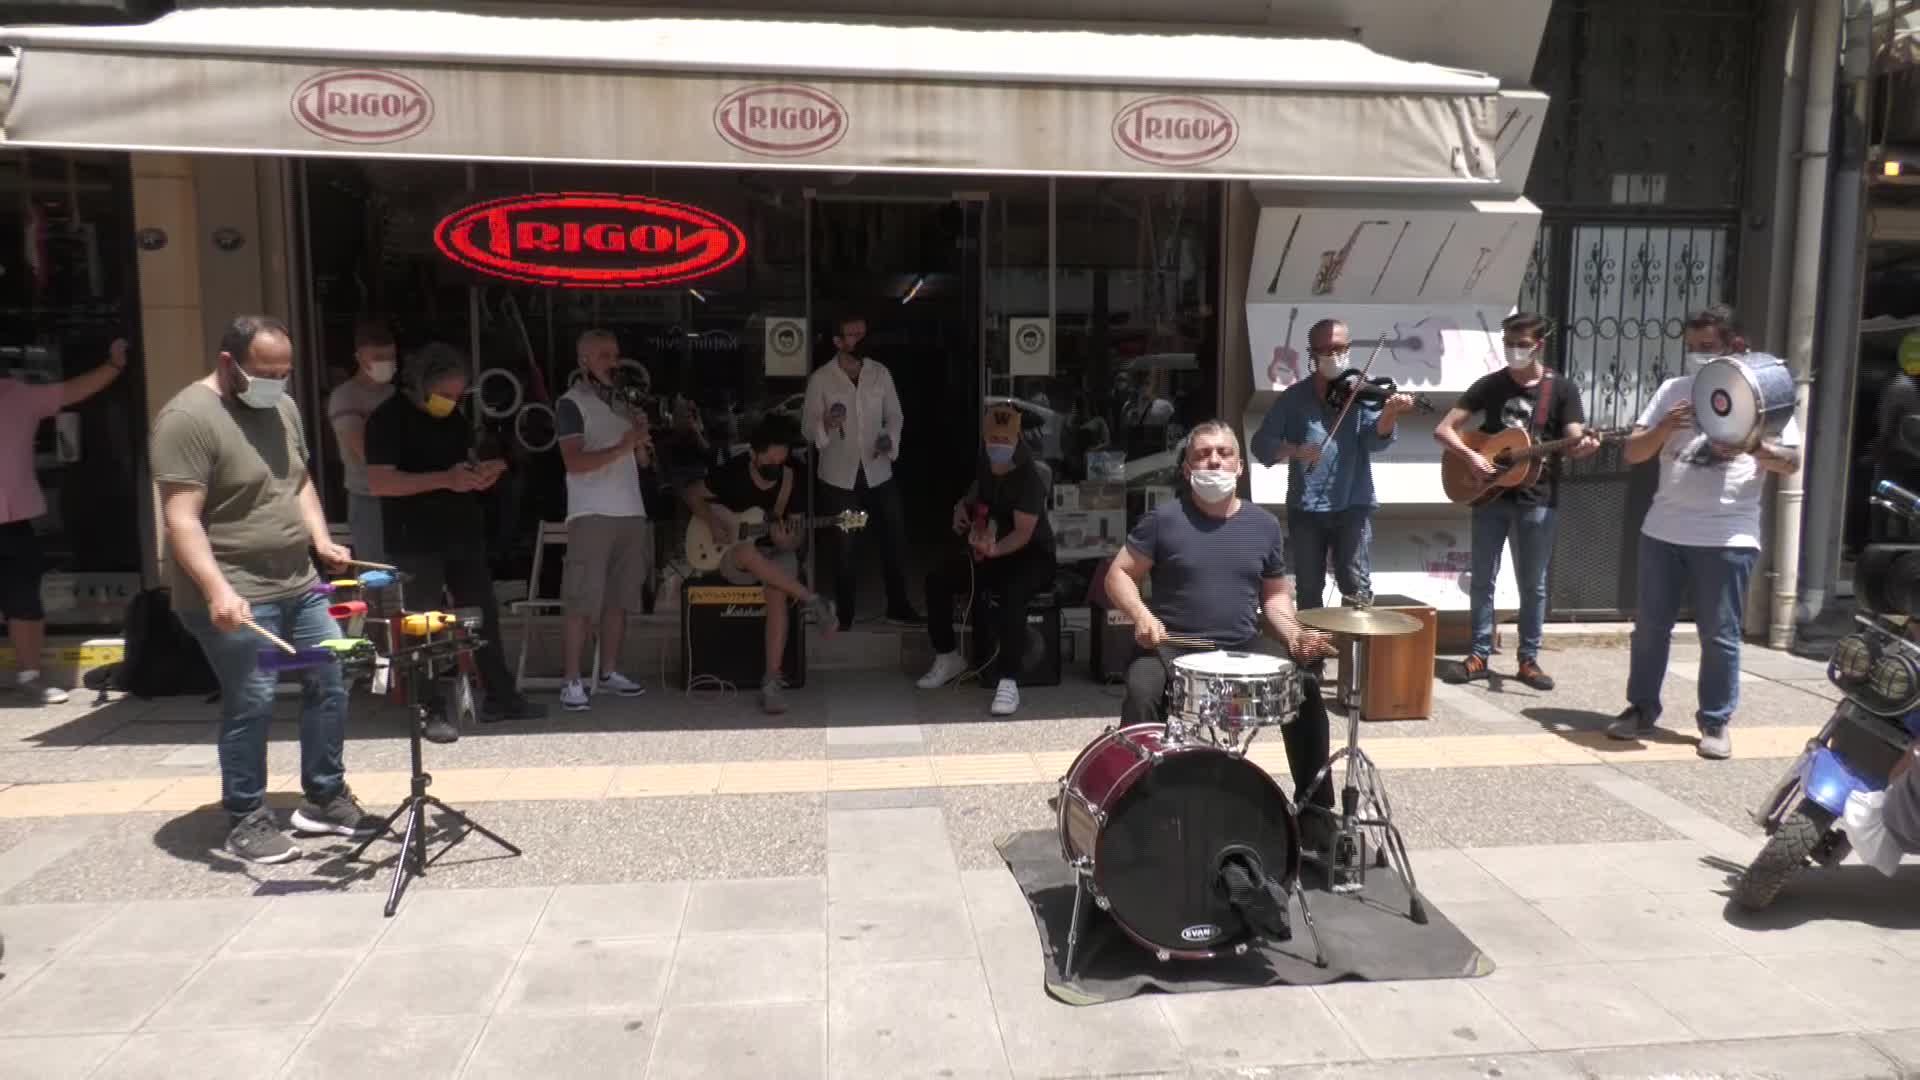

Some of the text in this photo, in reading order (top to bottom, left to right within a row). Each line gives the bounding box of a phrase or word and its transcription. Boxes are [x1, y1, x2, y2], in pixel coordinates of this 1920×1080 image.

[299, 78, 427, 126] TRIGON
[721, 94, 841, 141] TRIGON
[1120, 105, 1232, 150] TRIGON
[452, 206, 728, 264] TRIGON
